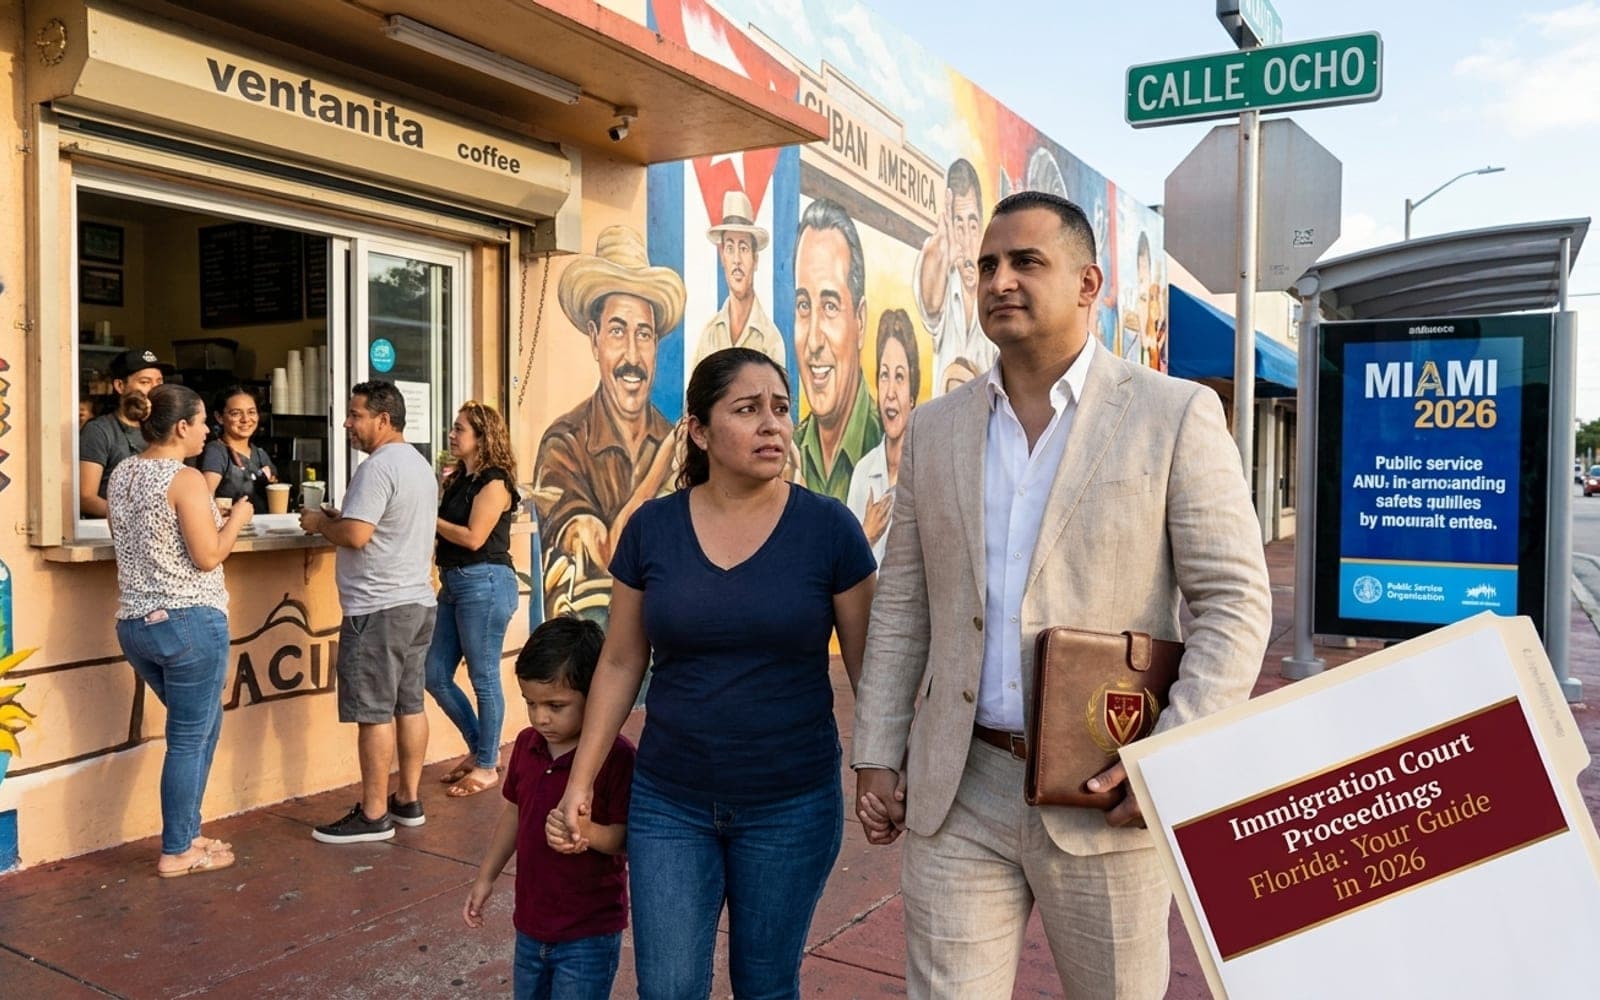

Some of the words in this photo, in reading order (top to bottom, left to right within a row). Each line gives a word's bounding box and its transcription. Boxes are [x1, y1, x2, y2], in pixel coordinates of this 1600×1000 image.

[1138, 62, 1245, 111] CALLE
[1263, 47, 1365, 95] OCHO
[206, 57, 424, 149] ventanita
[457, 141, 521, 174] coffee
[878, 143, 937, 214] AMERICA
[1365, 359, 1498, 398] MIAMI
[1414, 399, 1498, 428] 2026
[1375, 456, 1422, 470] Public
[1425, 456, 1483, 471] service
[1359, 512, 1378, 530] by
[1228, 766, 1396, 841] Immigration
[1398, 733, 1475, 775] Court
[1282, 780, 1443, 854] Proceedings
[1249, 849, 1349, 900] Florida:
[1350, 824, 1410, 859] Your
[1416, 793, 1491, 834] Guide
[1332, 877, 1363, 901] in
[1364, 846, 1427, 889] 2026
